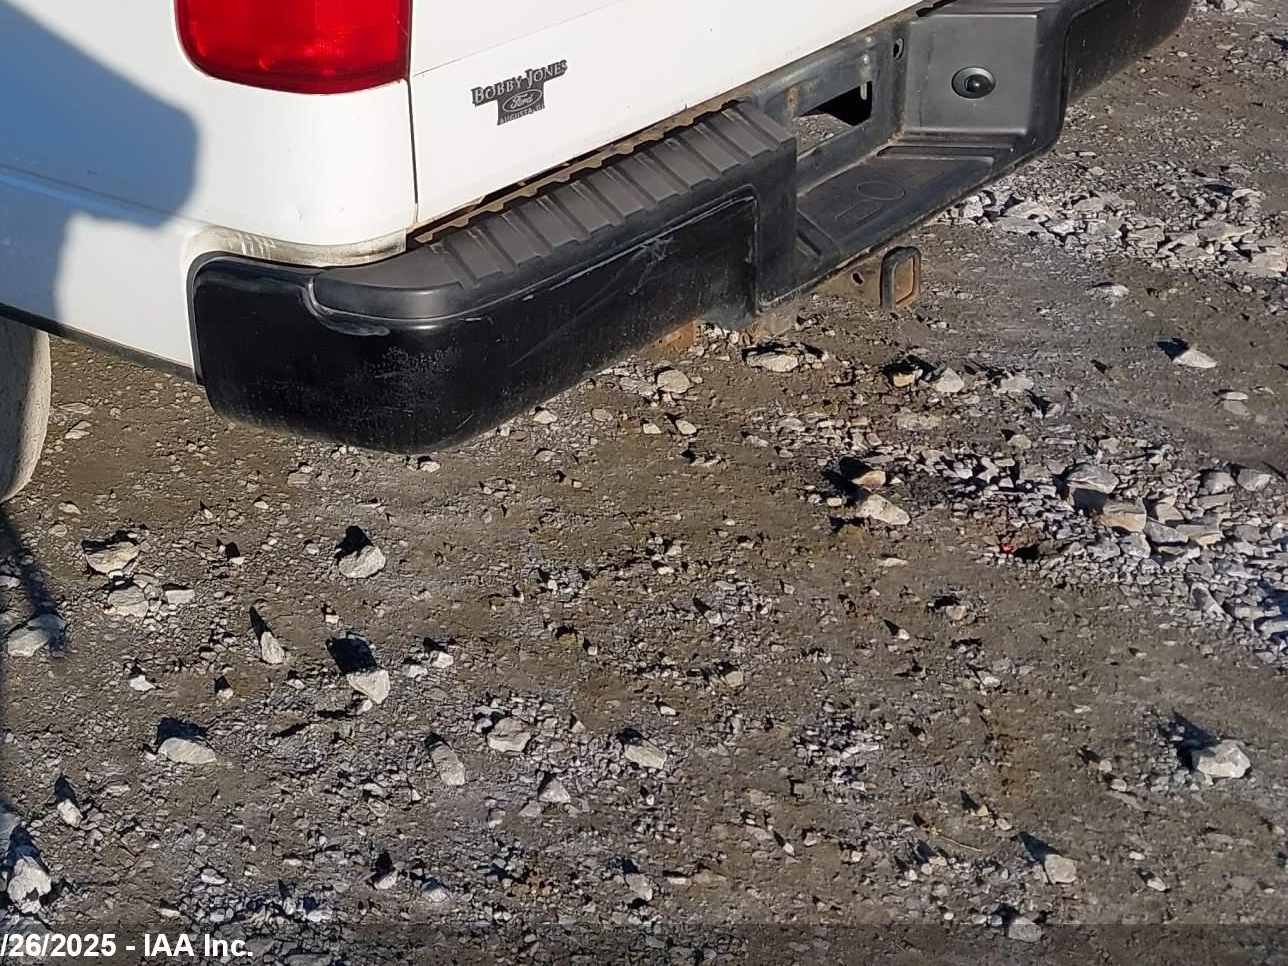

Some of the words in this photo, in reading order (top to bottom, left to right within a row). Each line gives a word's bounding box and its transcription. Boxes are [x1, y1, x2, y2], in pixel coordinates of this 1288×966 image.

[472, 76, 523, 105] BOBBY
[525, 59, 568, 89] JONES
[510, 92, 535, 109] Ford
